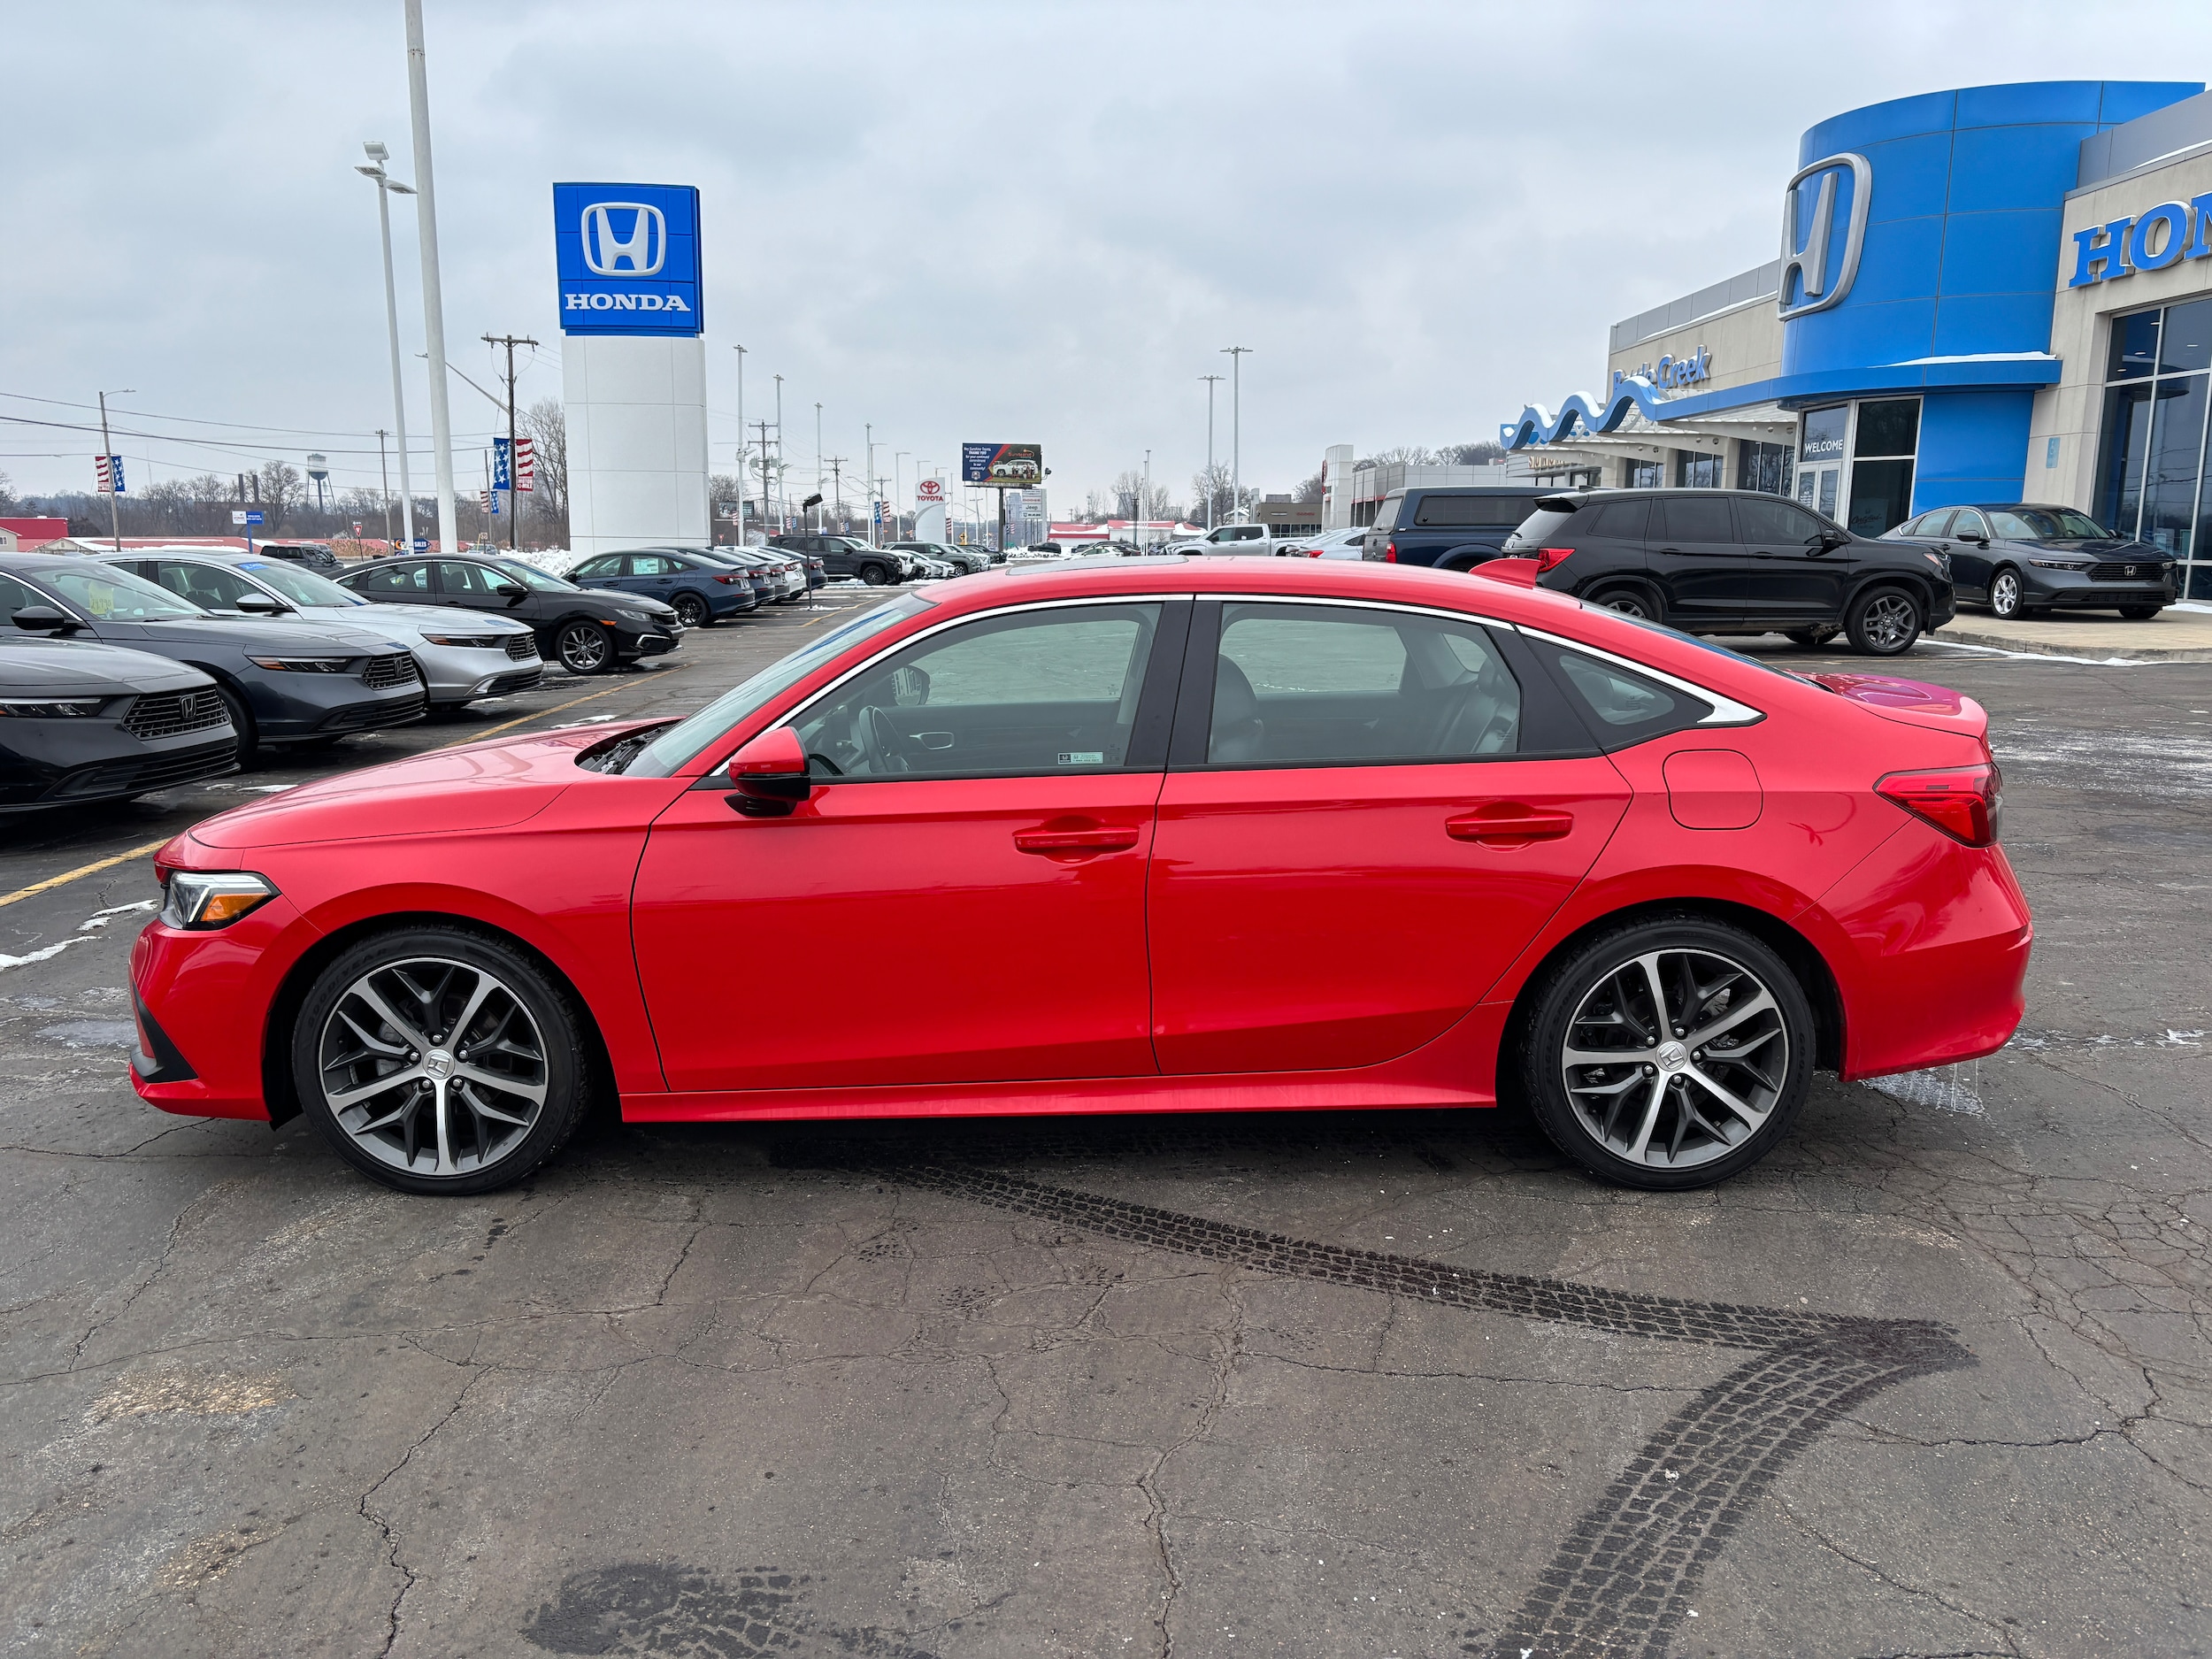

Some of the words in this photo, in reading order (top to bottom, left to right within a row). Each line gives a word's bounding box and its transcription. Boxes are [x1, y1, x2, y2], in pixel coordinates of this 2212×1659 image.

[565, 293, 691, 311] HONDA
[1657, 344, 1712, 388] Creek
[1805, 440, 1843, 453] WELCOME
